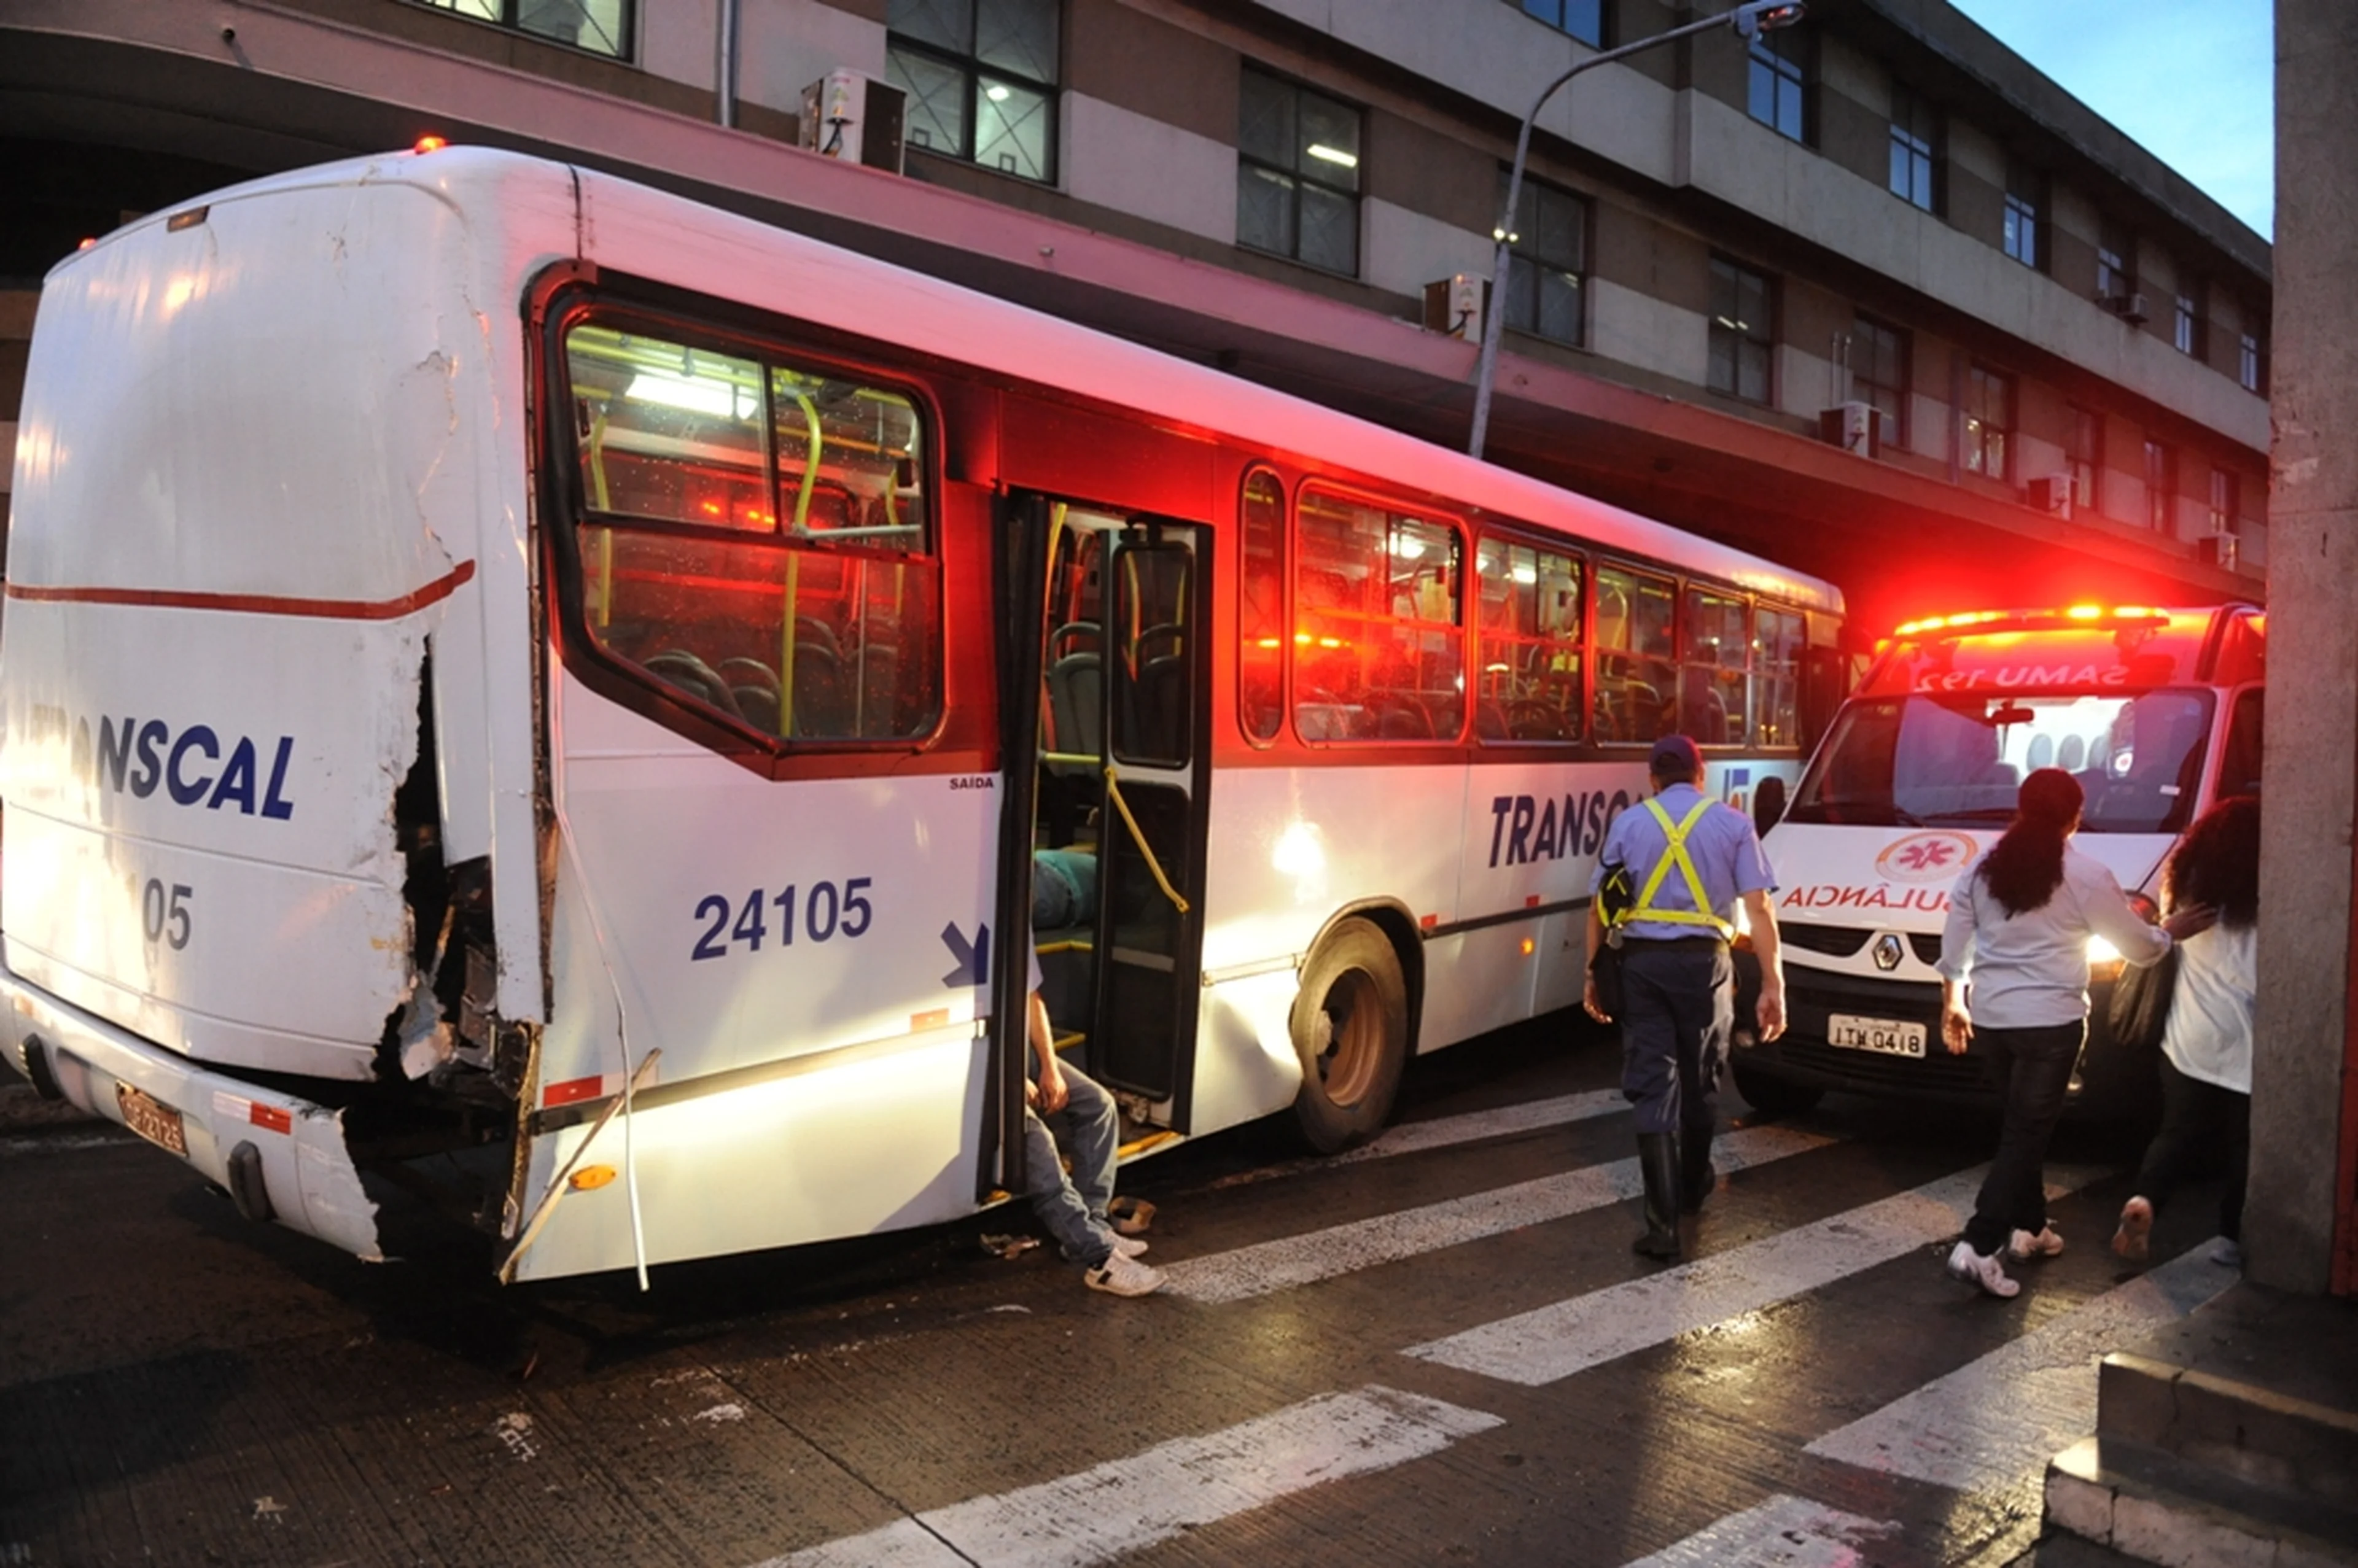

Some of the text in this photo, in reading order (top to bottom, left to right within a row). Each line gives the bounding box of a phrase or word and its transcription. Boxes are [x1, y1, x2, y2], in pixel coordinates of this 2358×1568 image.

[29, 704, 294, 820] ANSCAL
[1488, 789, 1659, 868] TRANSC
[691, 877, 872, 961] 24105
[1874, 1031, 1920, 1053] 0418
